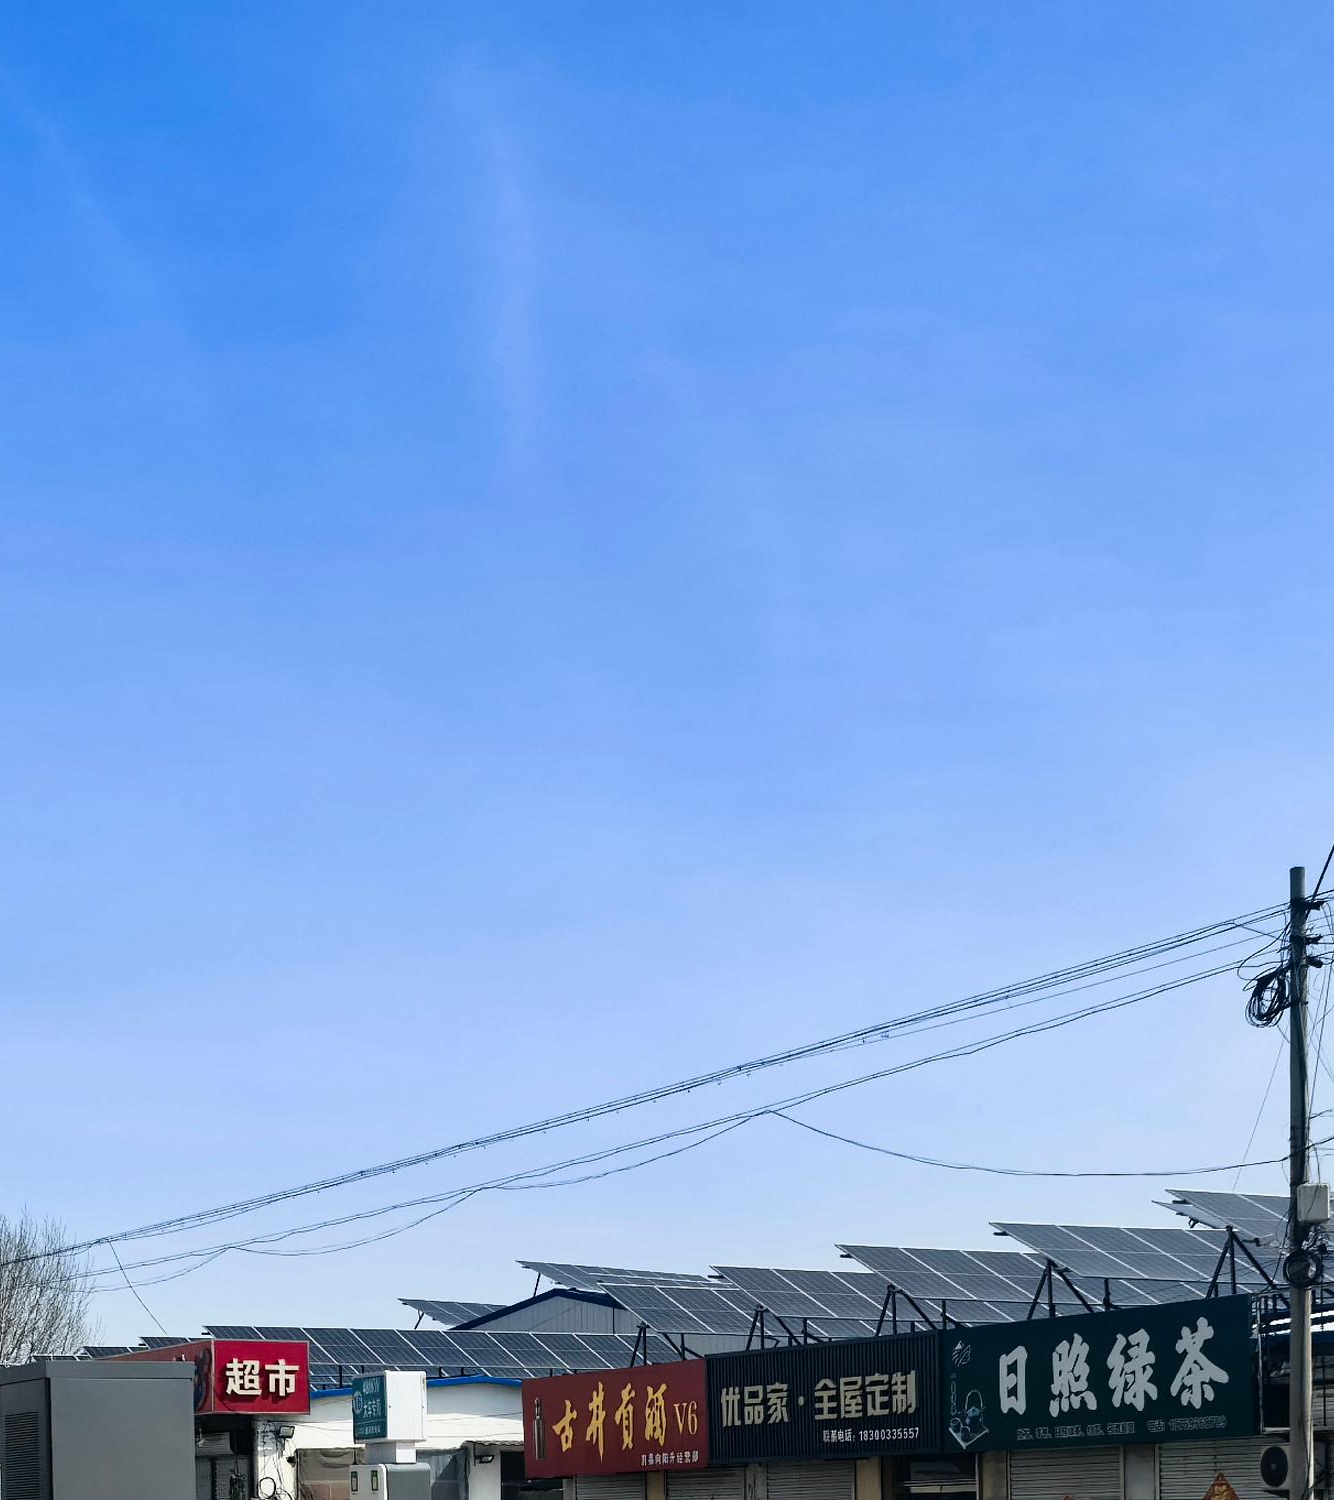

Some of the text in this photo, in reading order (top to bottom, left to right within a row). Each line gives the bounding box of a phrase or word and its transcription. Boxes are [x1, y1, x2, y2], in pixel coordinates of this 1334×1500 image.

[225, 1358, 299, 1397] 超市
[999, 1317, 1229, 1417] 日照绿茶
[552, 1381, 698, 1463] 古井贡酒 V6
